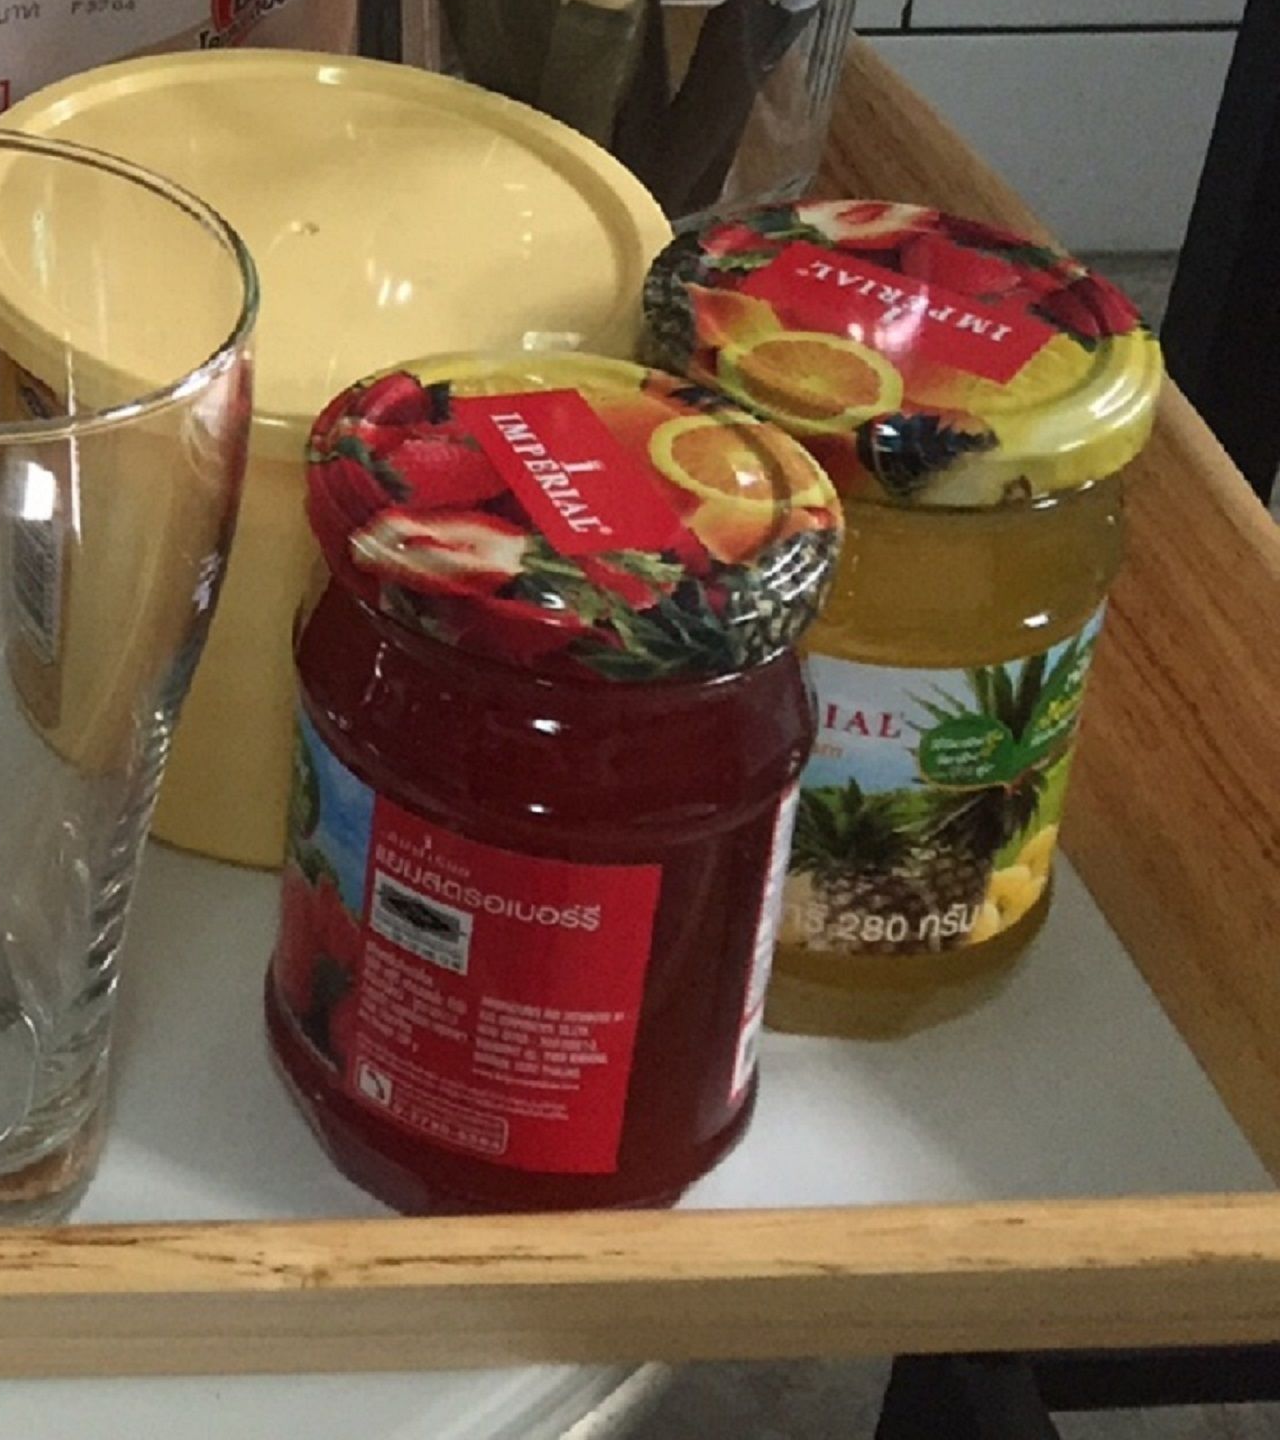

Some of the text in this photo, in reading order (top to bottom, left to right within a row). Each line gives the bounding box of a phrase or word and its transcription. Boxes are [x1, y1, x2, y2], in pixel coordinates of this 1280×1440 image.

[810, 260, 1013, 343] IMPRIAL
[490, 412, 604, 534] IMPERIAL
[838, 911, 910, 943] 280
